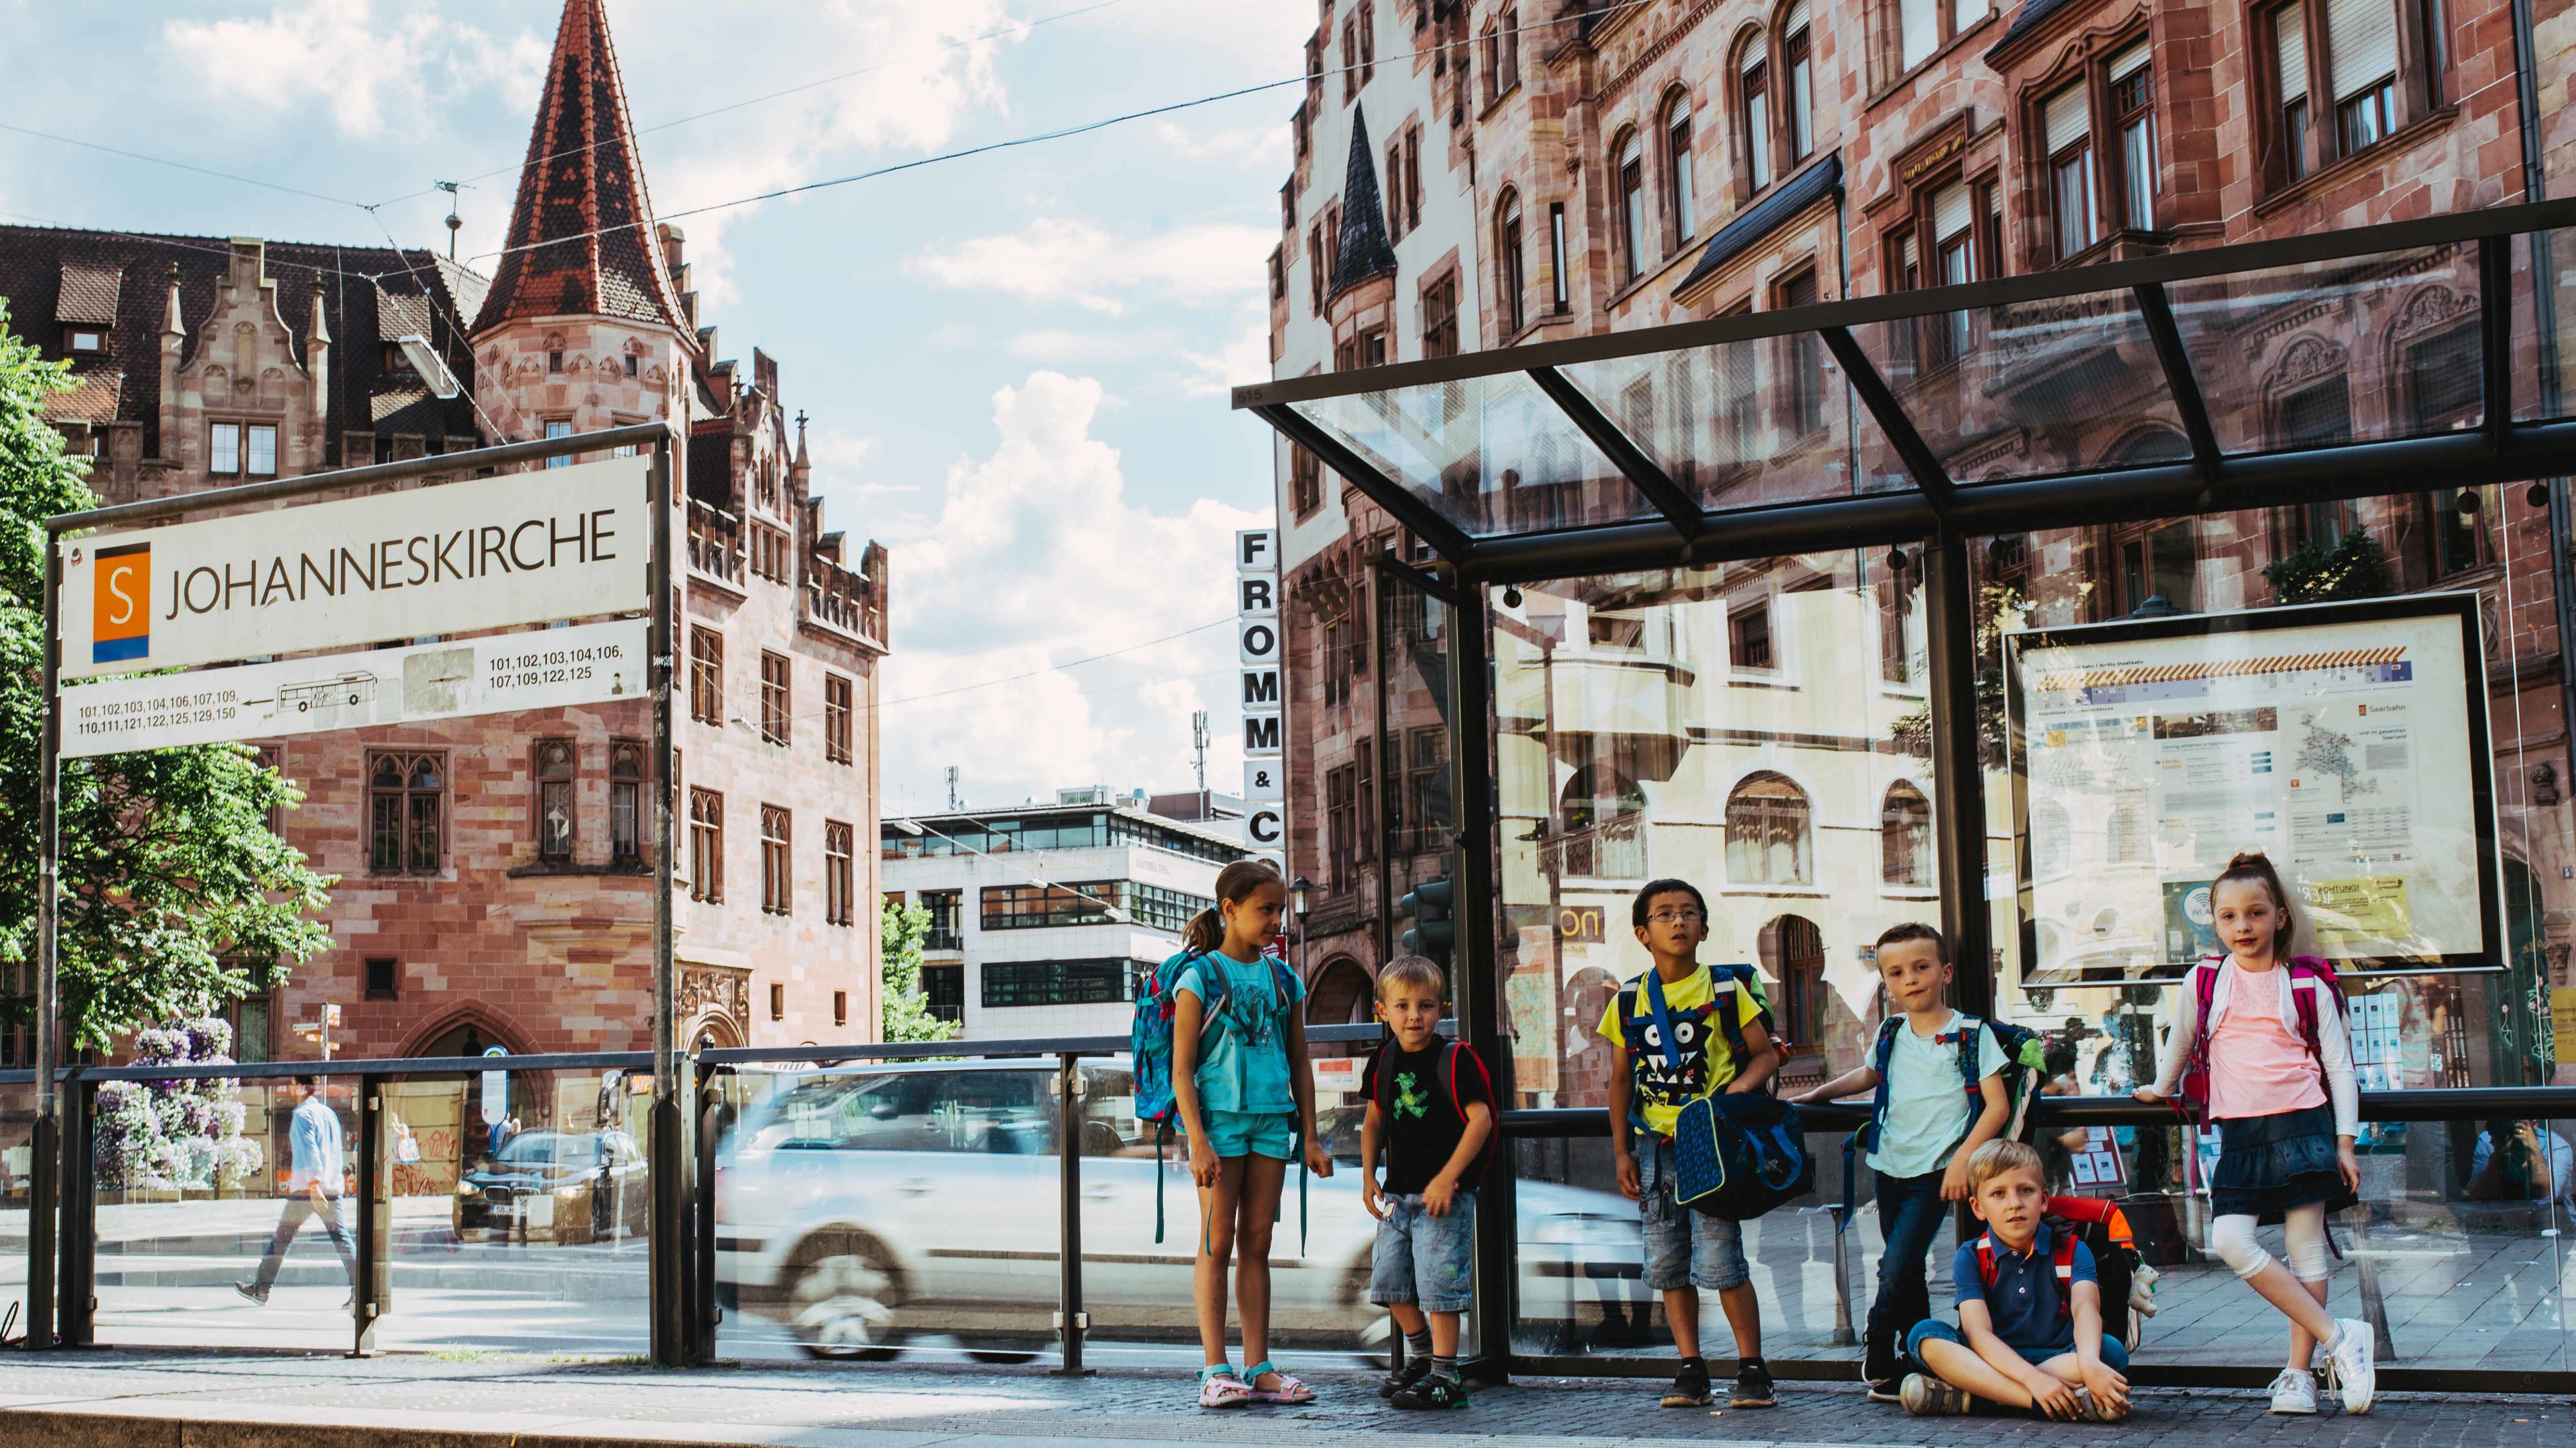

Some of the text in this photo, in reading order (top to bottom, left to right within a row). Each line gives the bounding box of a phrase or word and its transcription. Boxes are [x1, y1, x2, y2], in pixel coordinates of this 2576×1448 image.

[110, 509, 616, 625] S JOHANNESKIRCHE
[1242, 533, 1280, 749] FROMM
[2369, 704, 2405, 713] Saarbahn
[2318, 884, 2359, 893] ACHTUNG!
